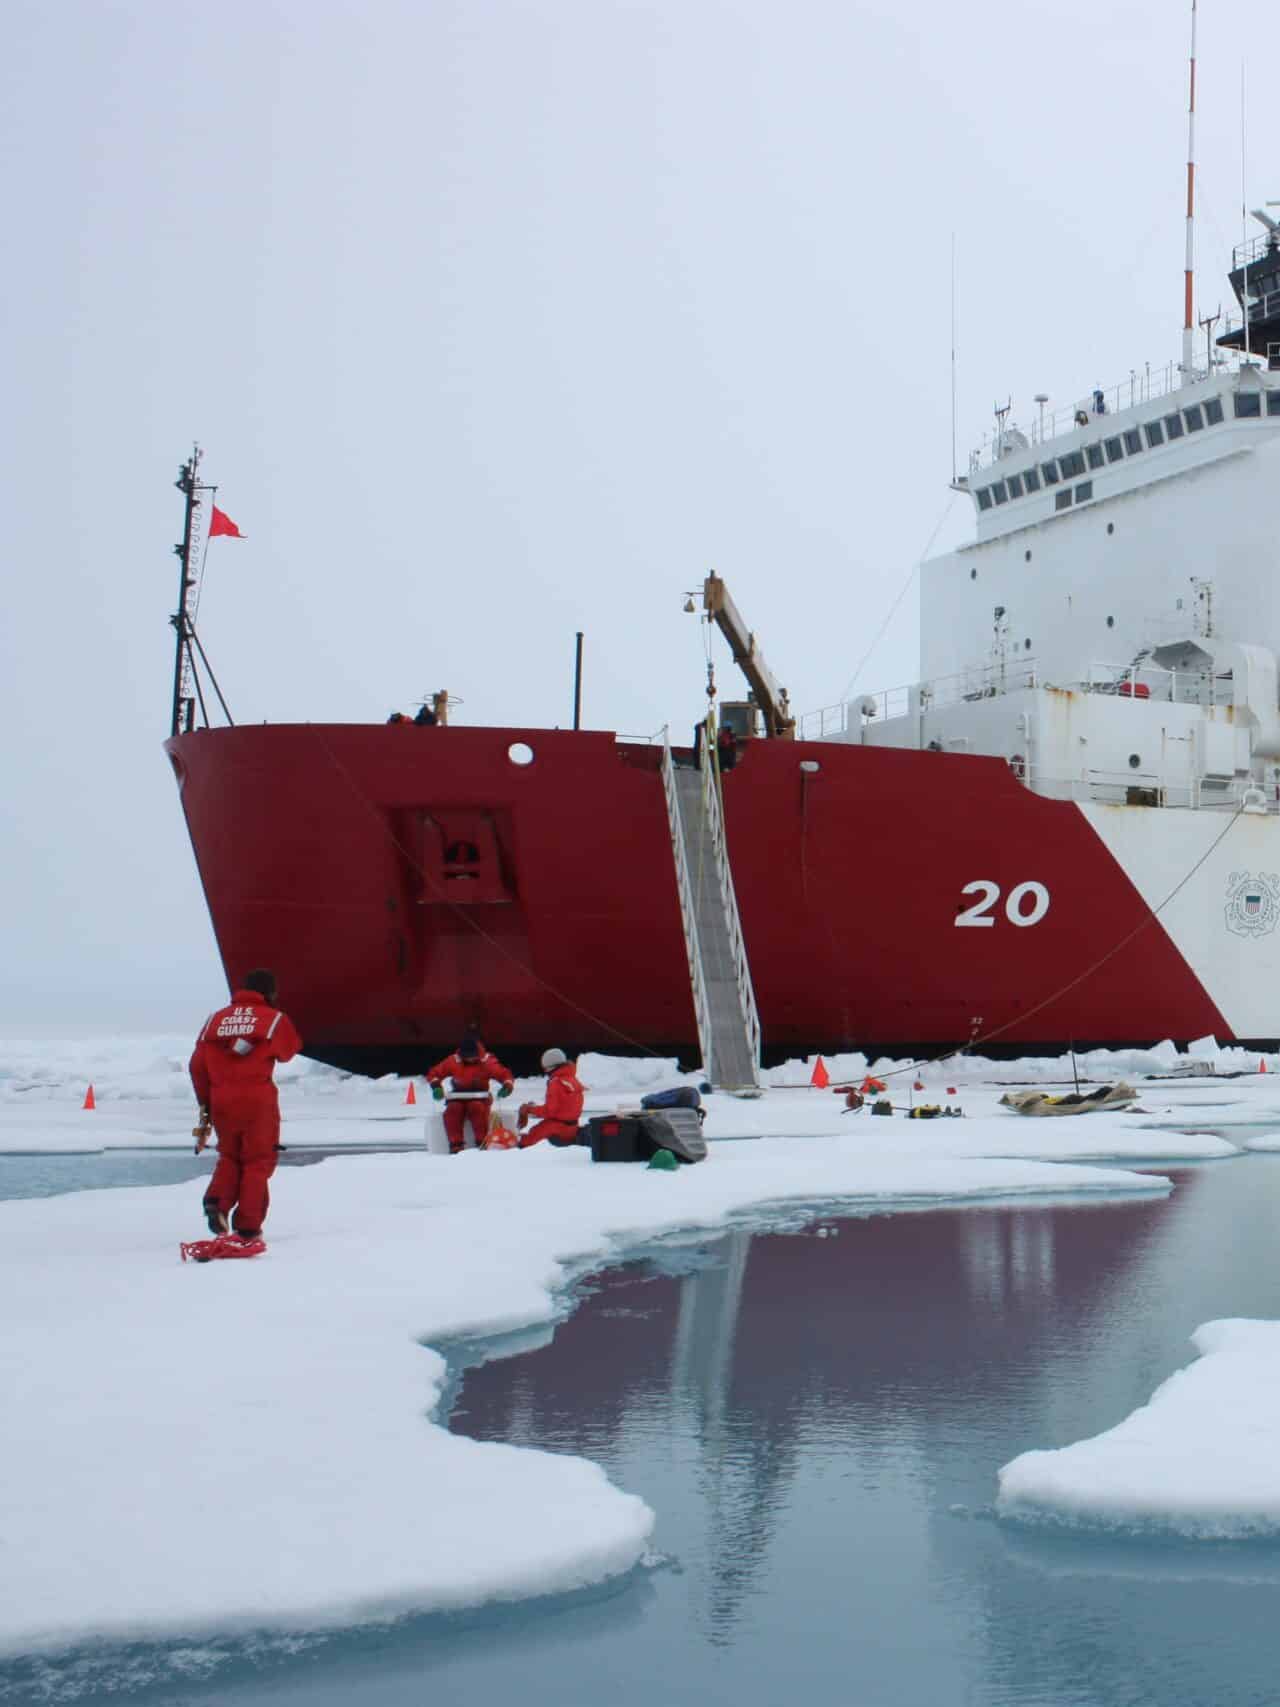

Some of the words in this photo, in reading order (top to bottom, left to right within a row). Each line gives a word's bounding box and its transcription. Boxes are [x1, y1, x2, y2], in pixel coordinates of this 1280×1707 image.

[954, 880, 1050, 928] 20
[222, 1016, 257, 1025] COAST
[217, 1025, 254, 1036] GUARD
